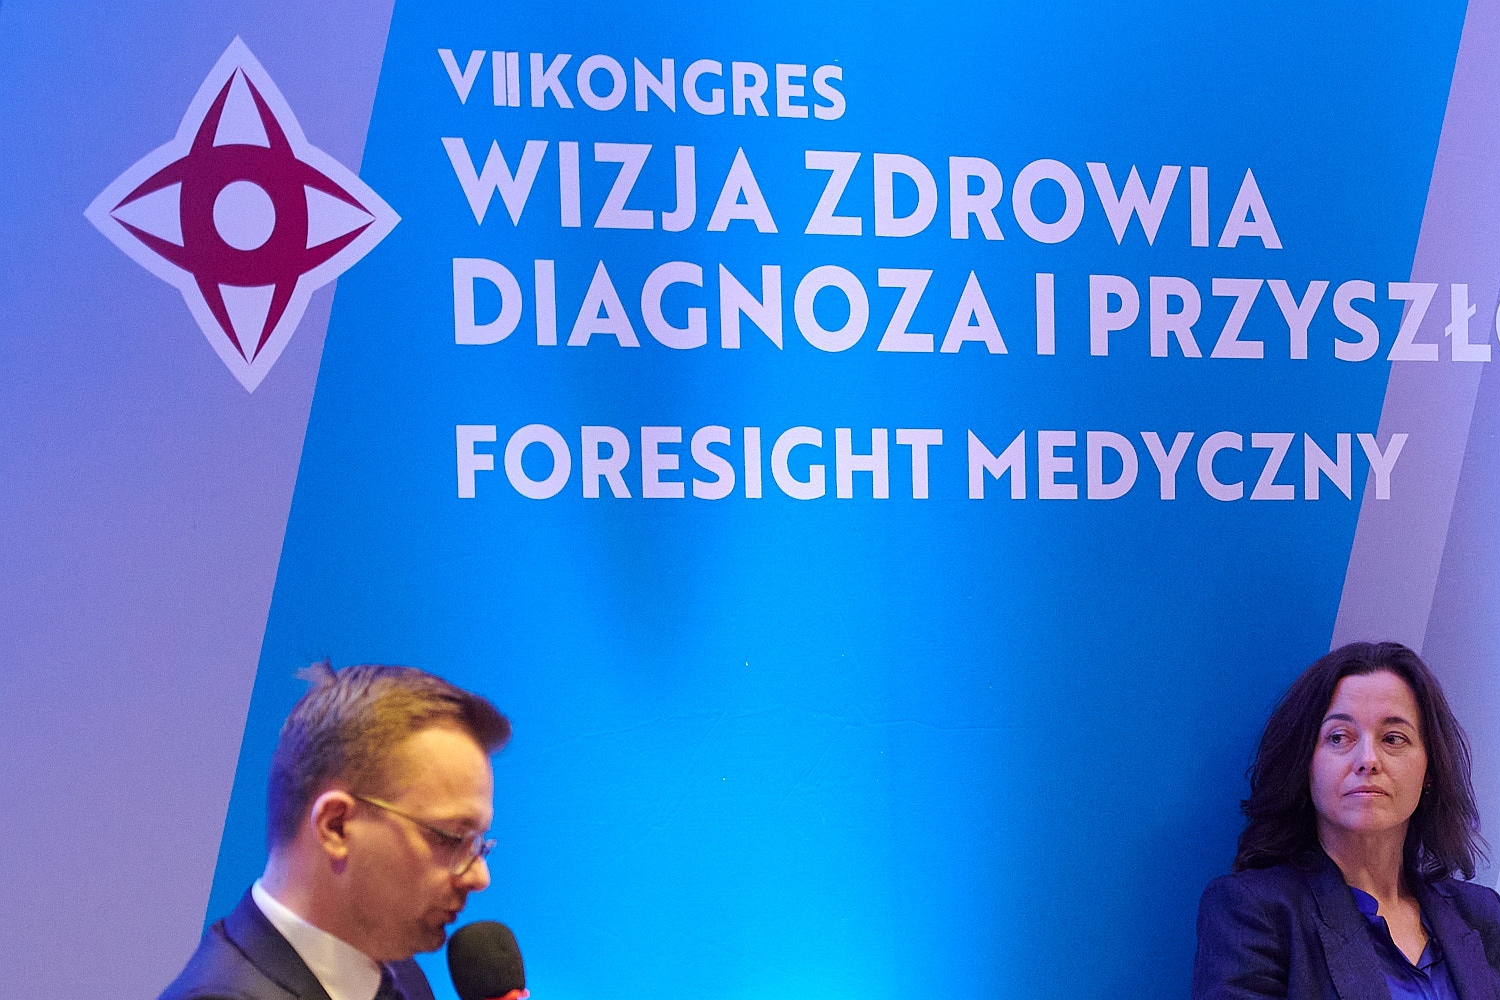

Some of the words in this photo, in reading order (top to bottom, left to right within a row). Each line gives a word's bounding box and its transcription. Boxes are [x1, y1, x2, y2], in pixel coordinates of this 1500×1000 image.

[441, 137, 779, 234] WIZJA
[804, 149, 1284, 250] ZDROWIA
[452, 257, 1009, 355] DIAGNOZA
[1035, 272, 1056, 356] I
[455, 423, 943, 501] FORESIGHT
[967, 429, 1409, 502] MEDYCZNY
